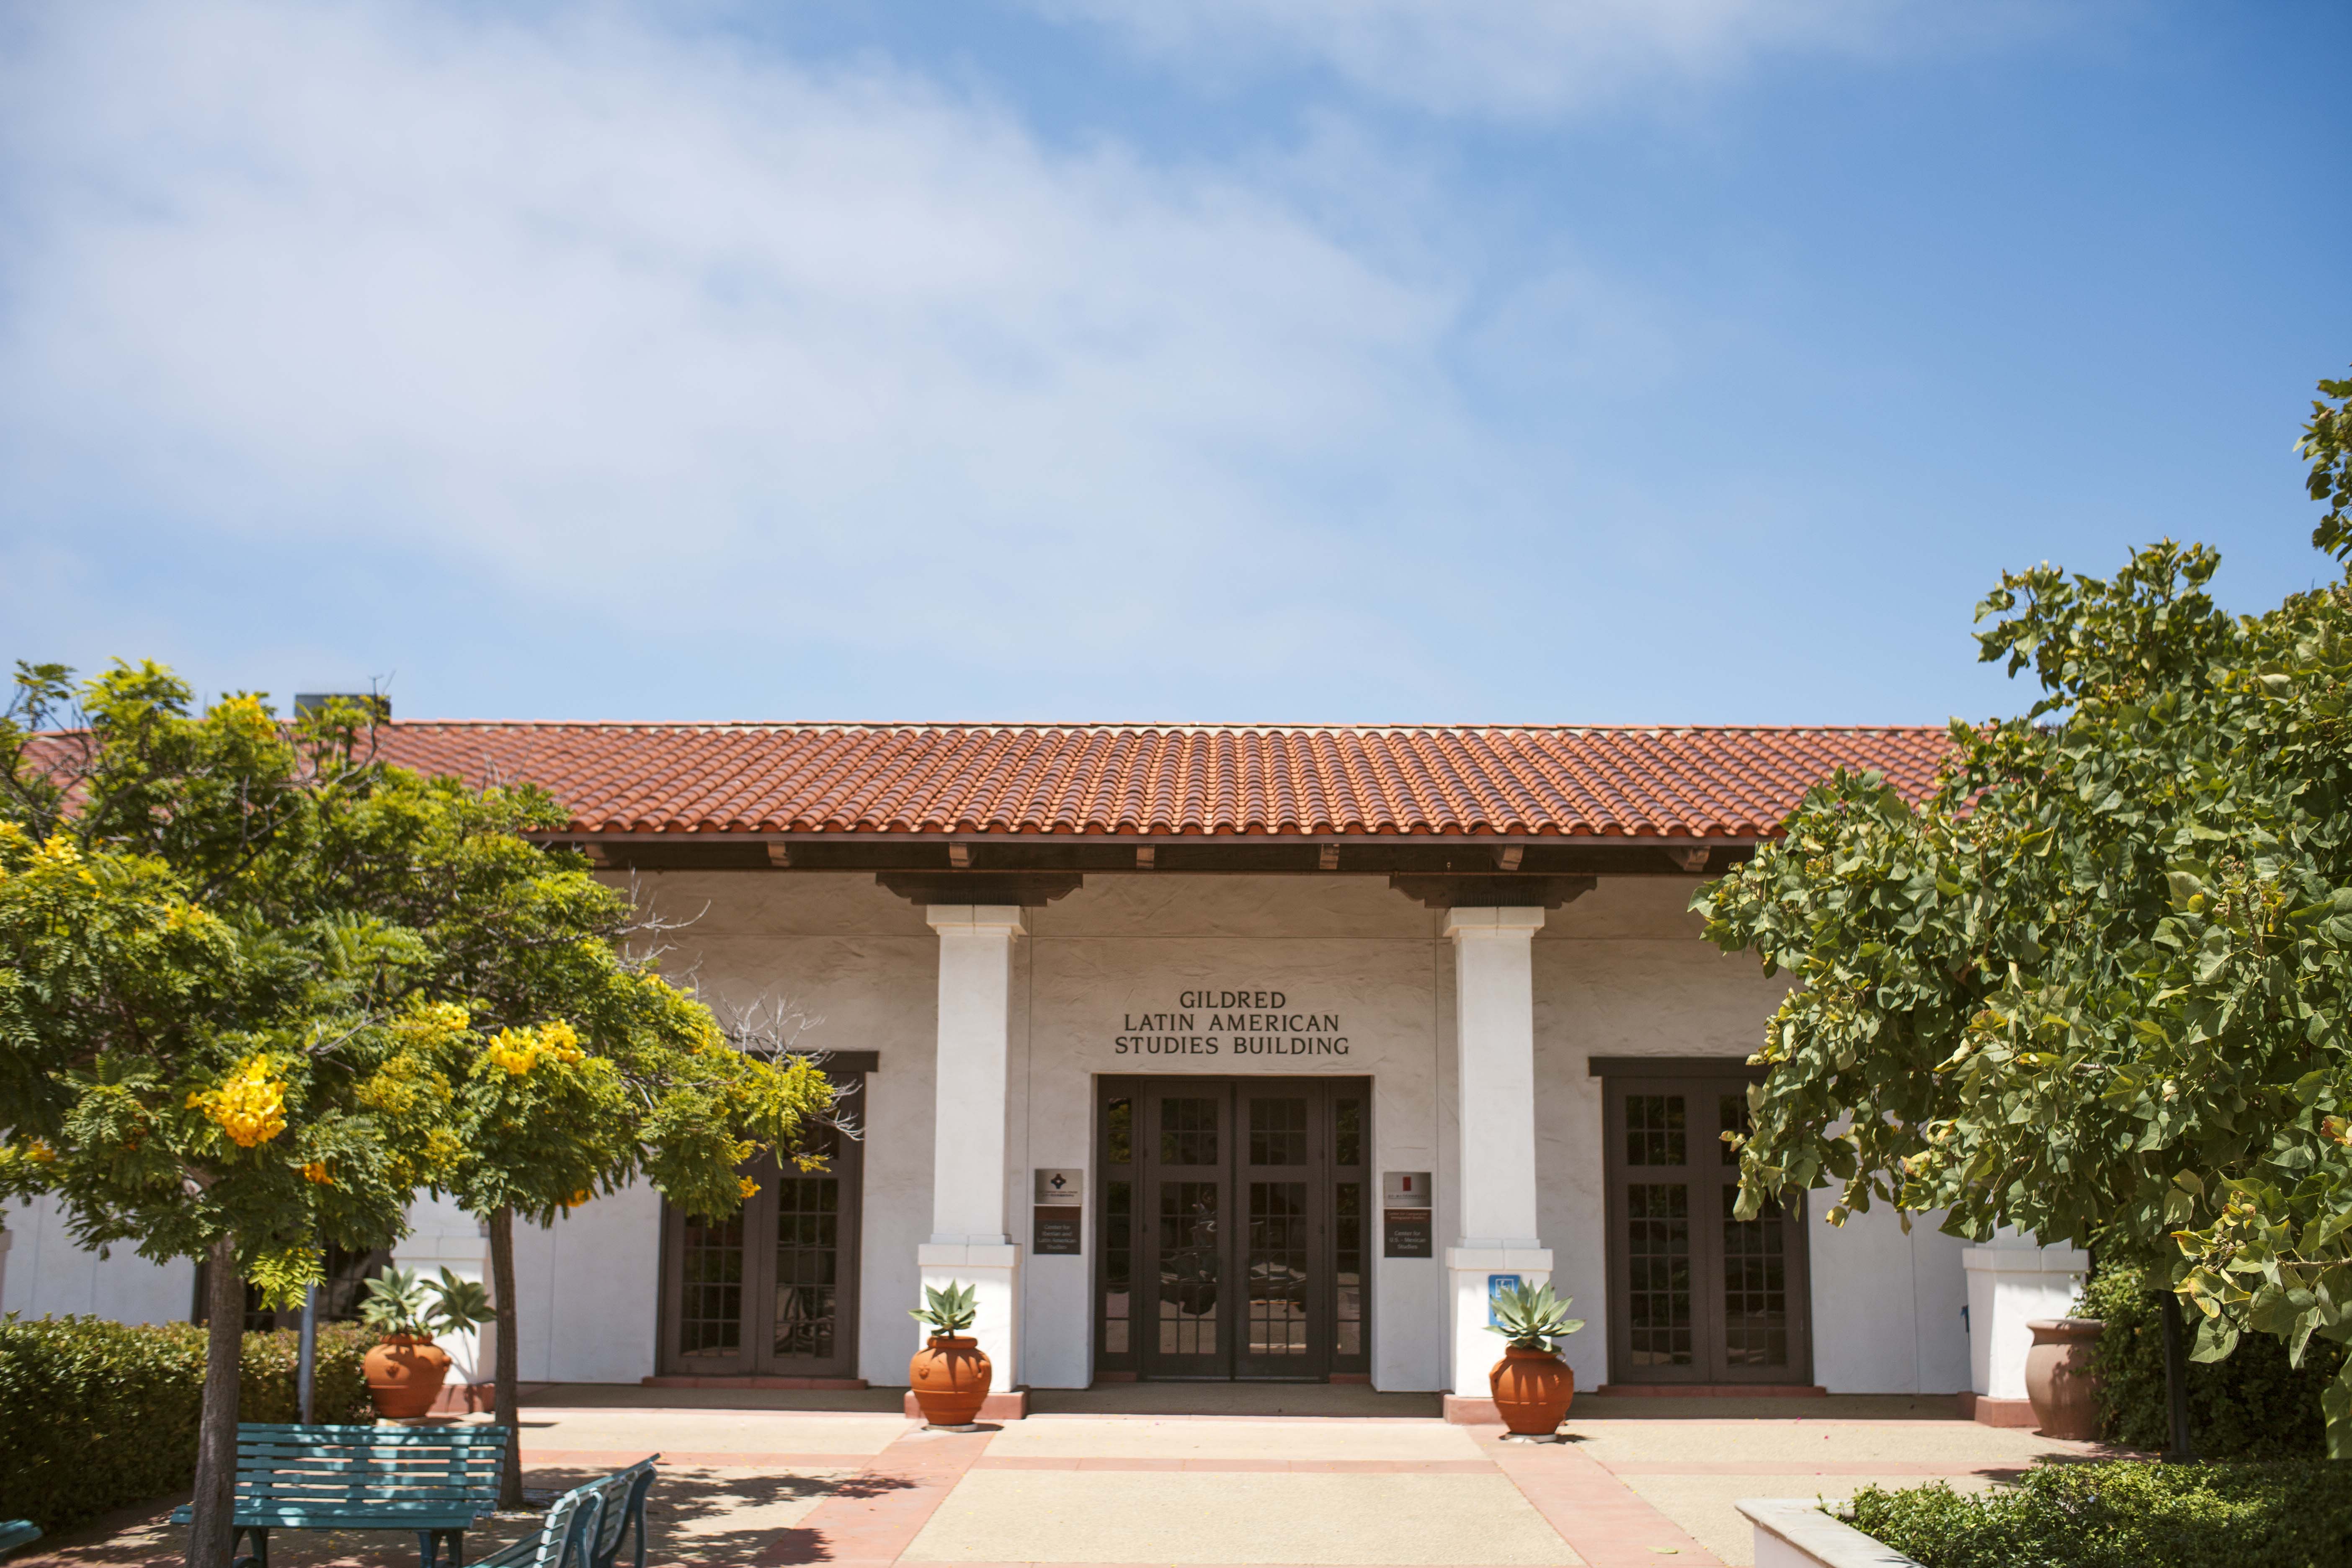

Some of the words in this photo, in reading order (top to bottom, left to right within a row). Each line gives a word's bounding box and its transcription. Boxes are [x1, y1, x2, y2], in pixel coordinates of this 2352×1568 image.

[1180, 991, 1286, 1008] GILDRED
[1125, 1014, 1194, 1031] LATIN
[1209, 1014, 1338, 1032] AMERICAN
[1116, 1037, 1218, 1054] STUDIES
[1234, 1037, 1349, 1055] BUILDING
